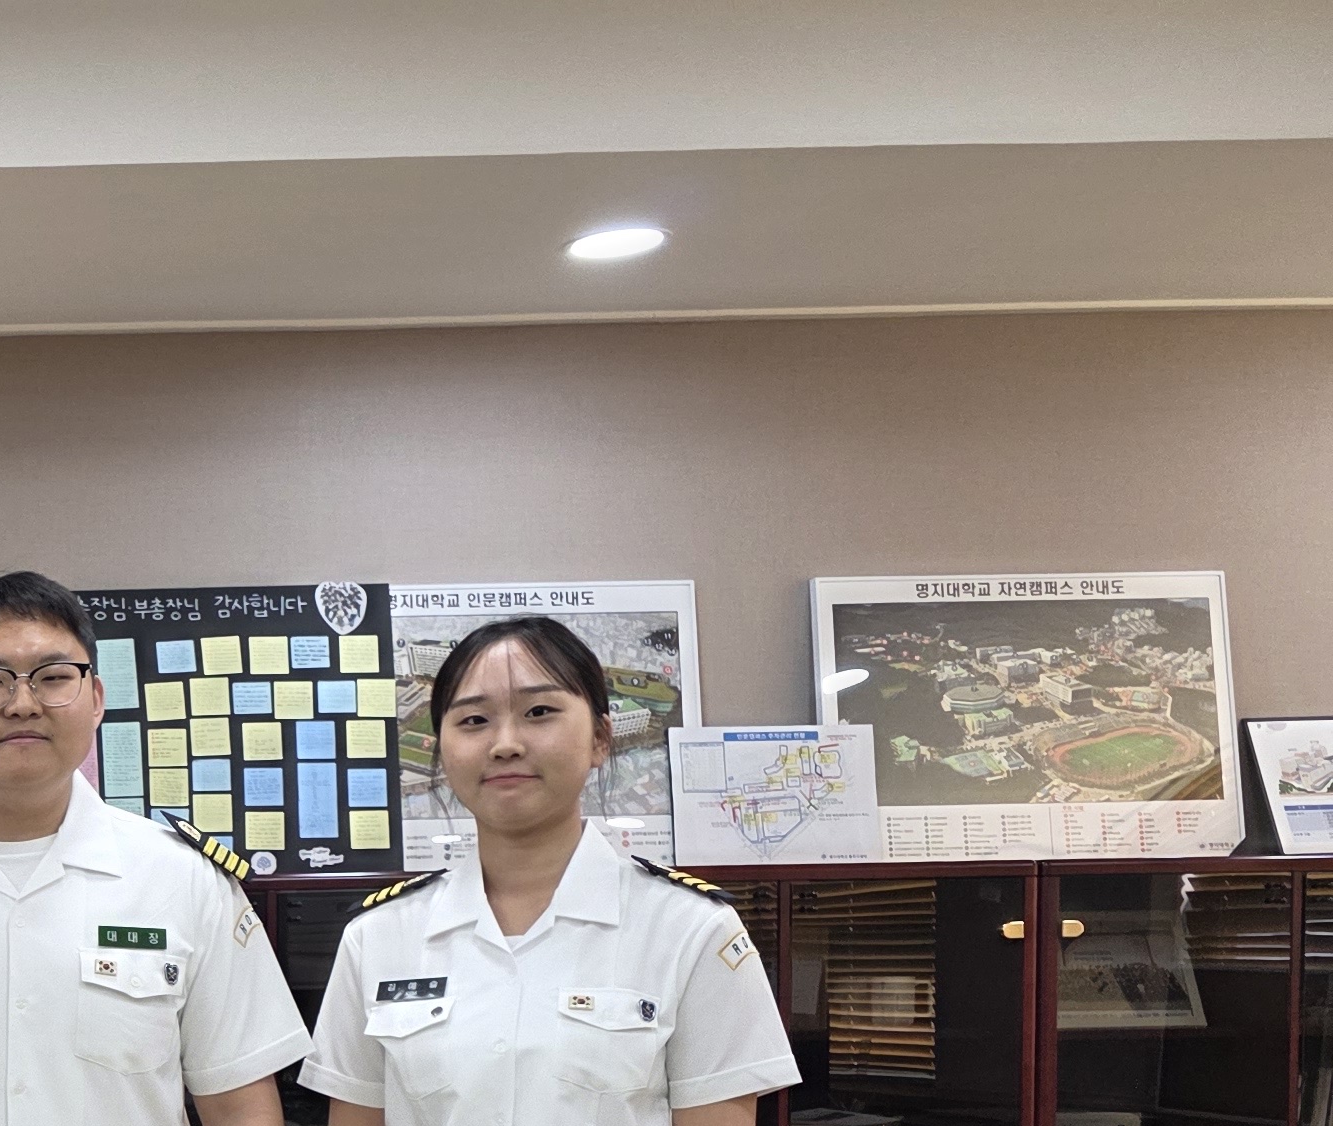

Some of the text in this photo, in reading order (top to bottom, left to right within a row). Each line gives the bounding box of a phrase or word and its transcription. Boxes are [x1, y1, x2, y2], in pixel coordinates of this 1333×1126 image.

[915, 579, 1125, 598] 명지대학교 자연캠퍼스 안내도
[214, 593, 308, 618] 감사합니다
[467, 592, 544, 608] 인문캠퍼스
[550, 591, 595, 607] 안내도
[731, 936, 749, 956] RO
